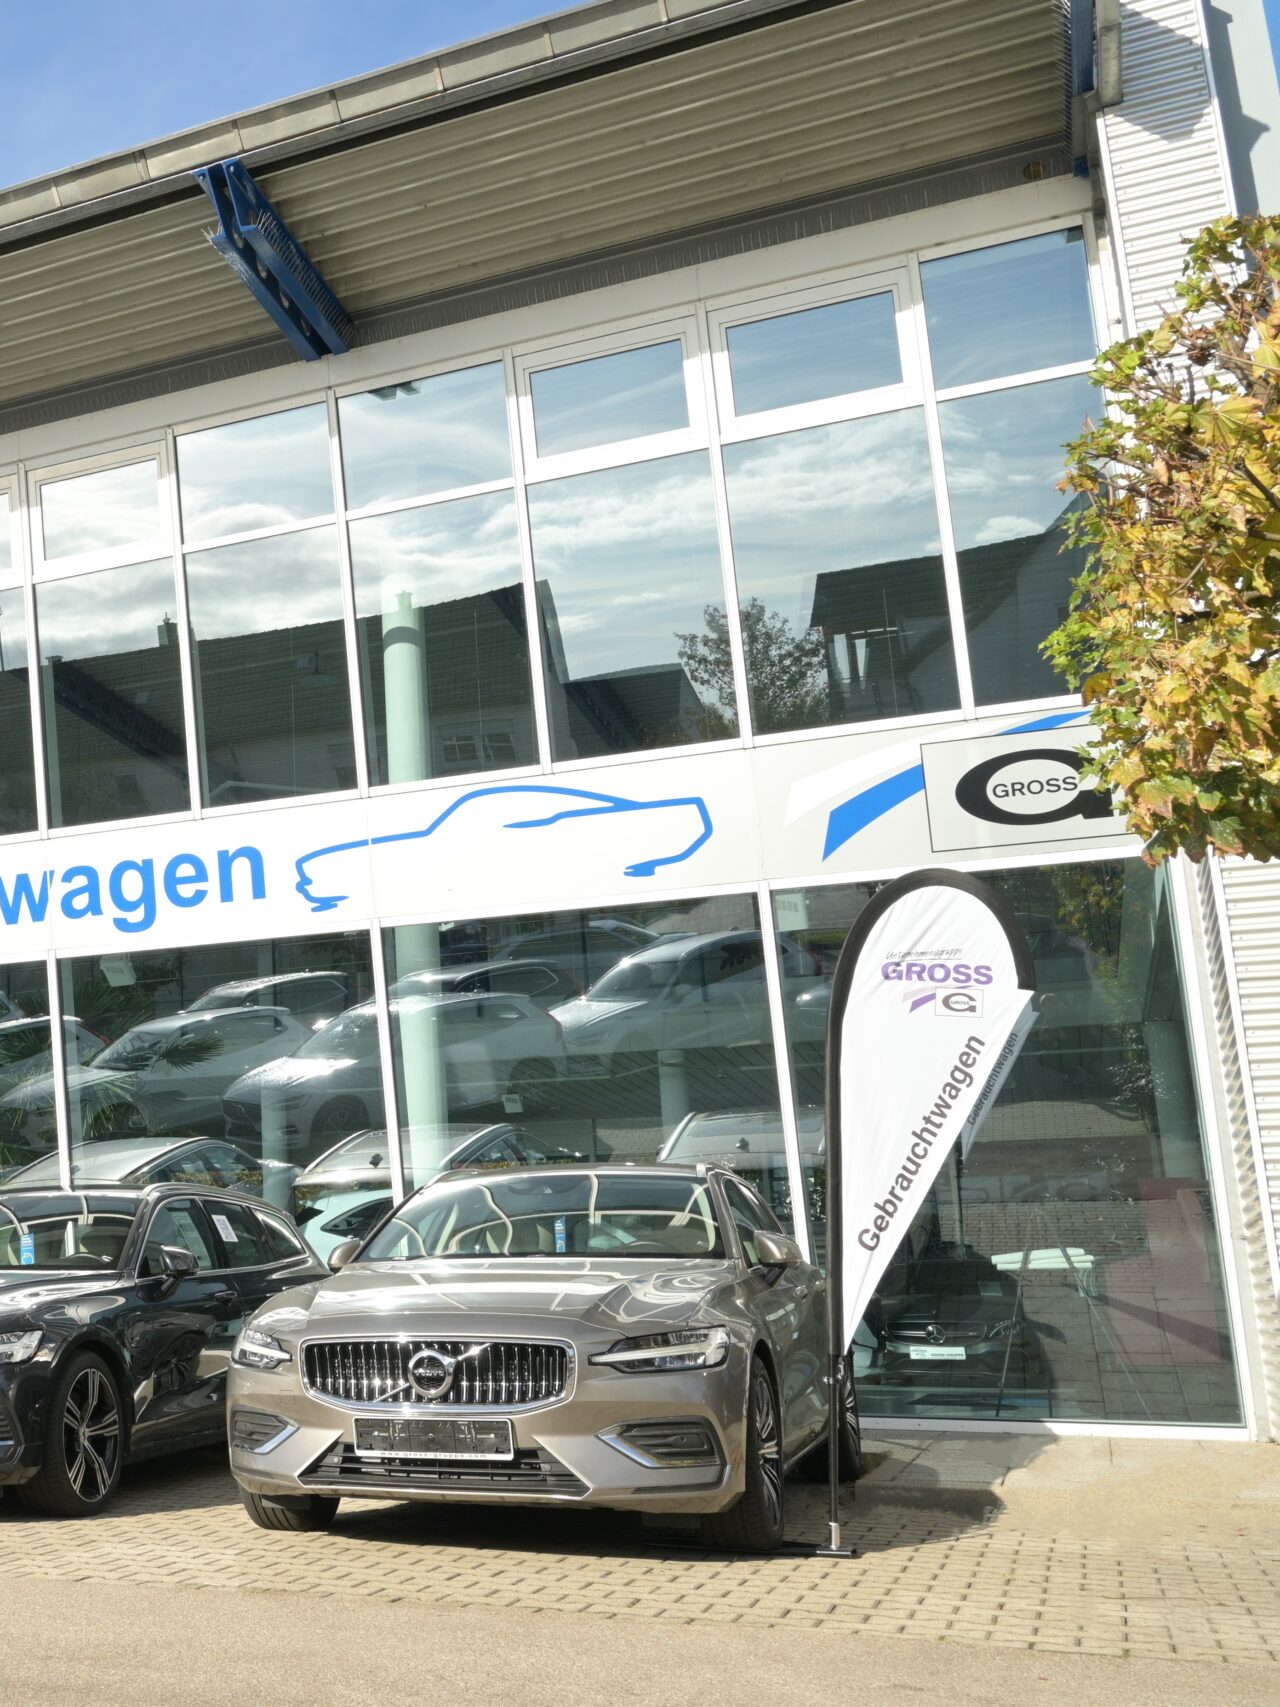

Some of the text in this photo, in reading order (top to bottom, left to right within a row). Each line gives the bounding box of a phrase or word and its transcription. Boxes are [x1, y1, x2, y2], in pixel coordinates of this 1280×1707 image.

[992, 775, 1079, 799] GROSS
[881, 961, 994, 985] GROSS
[967, 1032, 1019, 1126] Gebrauchtwagen
[858, 1035, 986, 1253] Gebrauchtwagen
